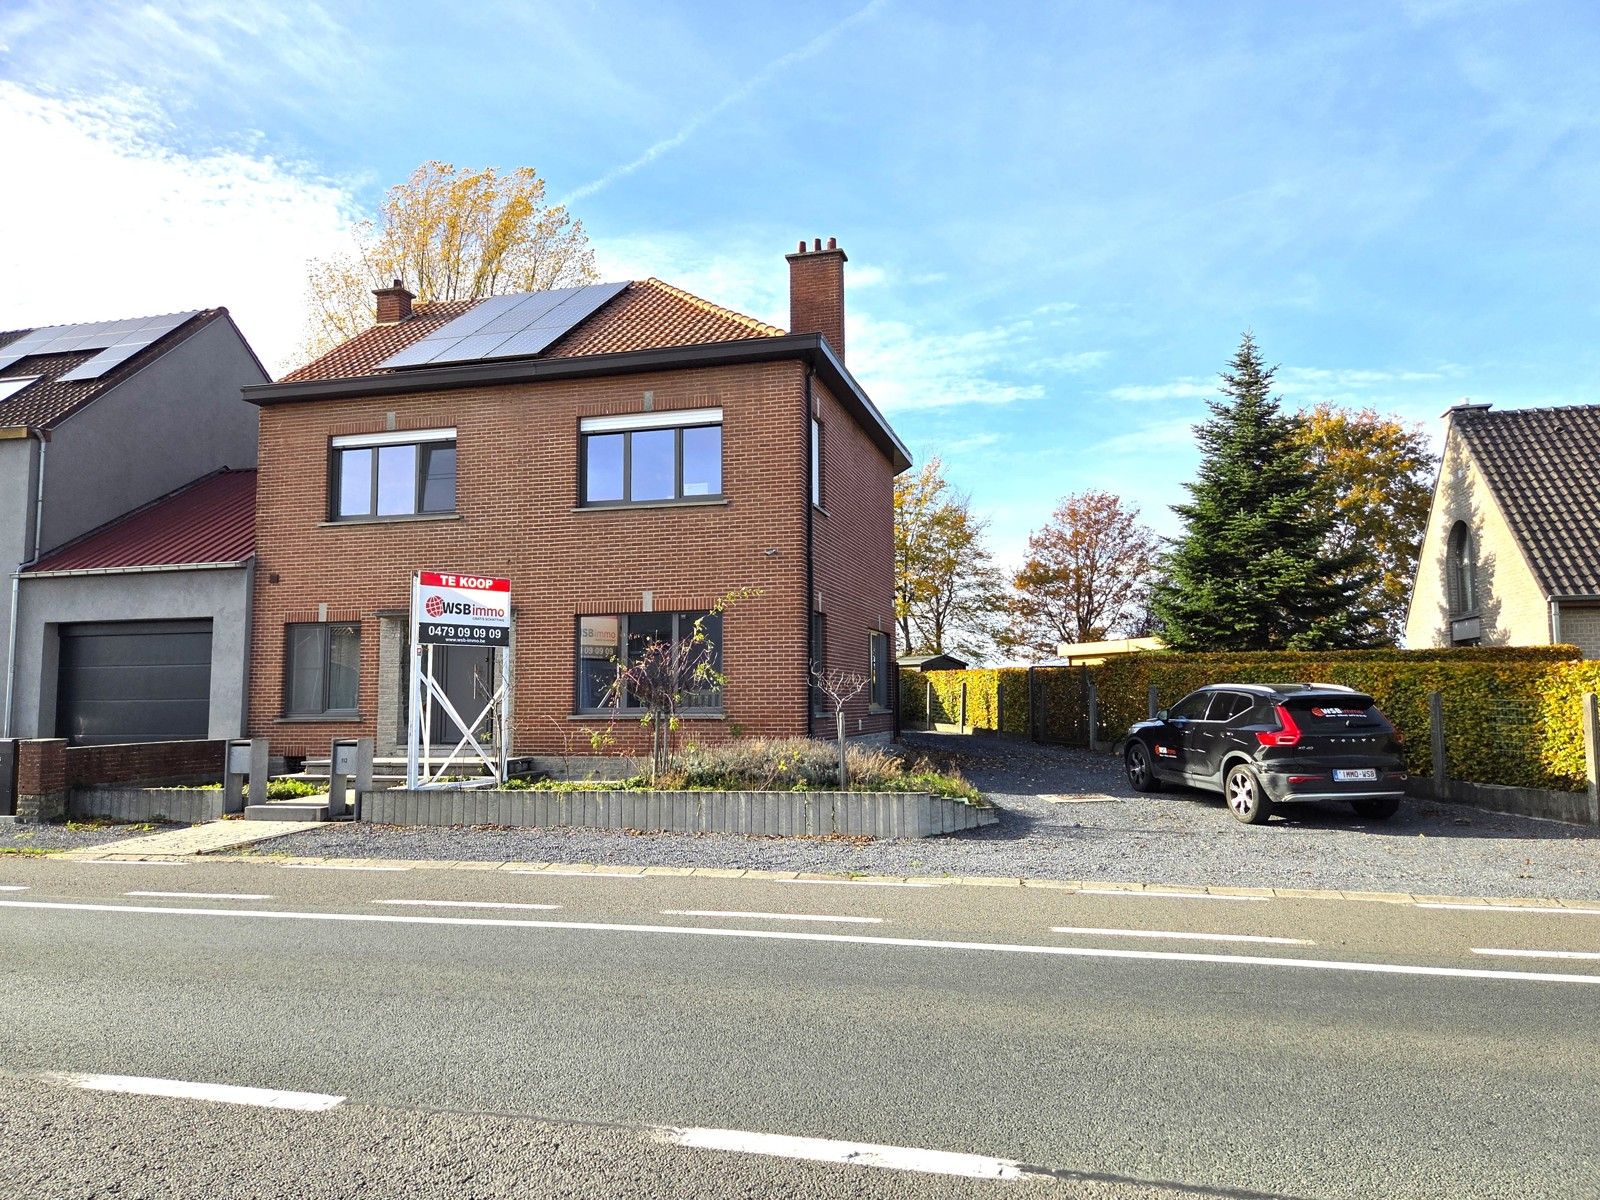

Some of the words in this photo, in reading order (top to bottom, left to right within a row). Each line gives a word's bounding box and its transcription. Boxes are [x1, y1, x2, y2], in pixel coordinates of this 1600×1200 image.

[440, 575, 456, 586] TE
[460, 577, 493, 589] KOOP
[428, 626, 454, 636] 0479
[457, 627, 470, 637] 09
[473, 628, 486, 638] 09
[489, 629, 501, 639] 09
[582, 628, 616, 639] SBimmo
